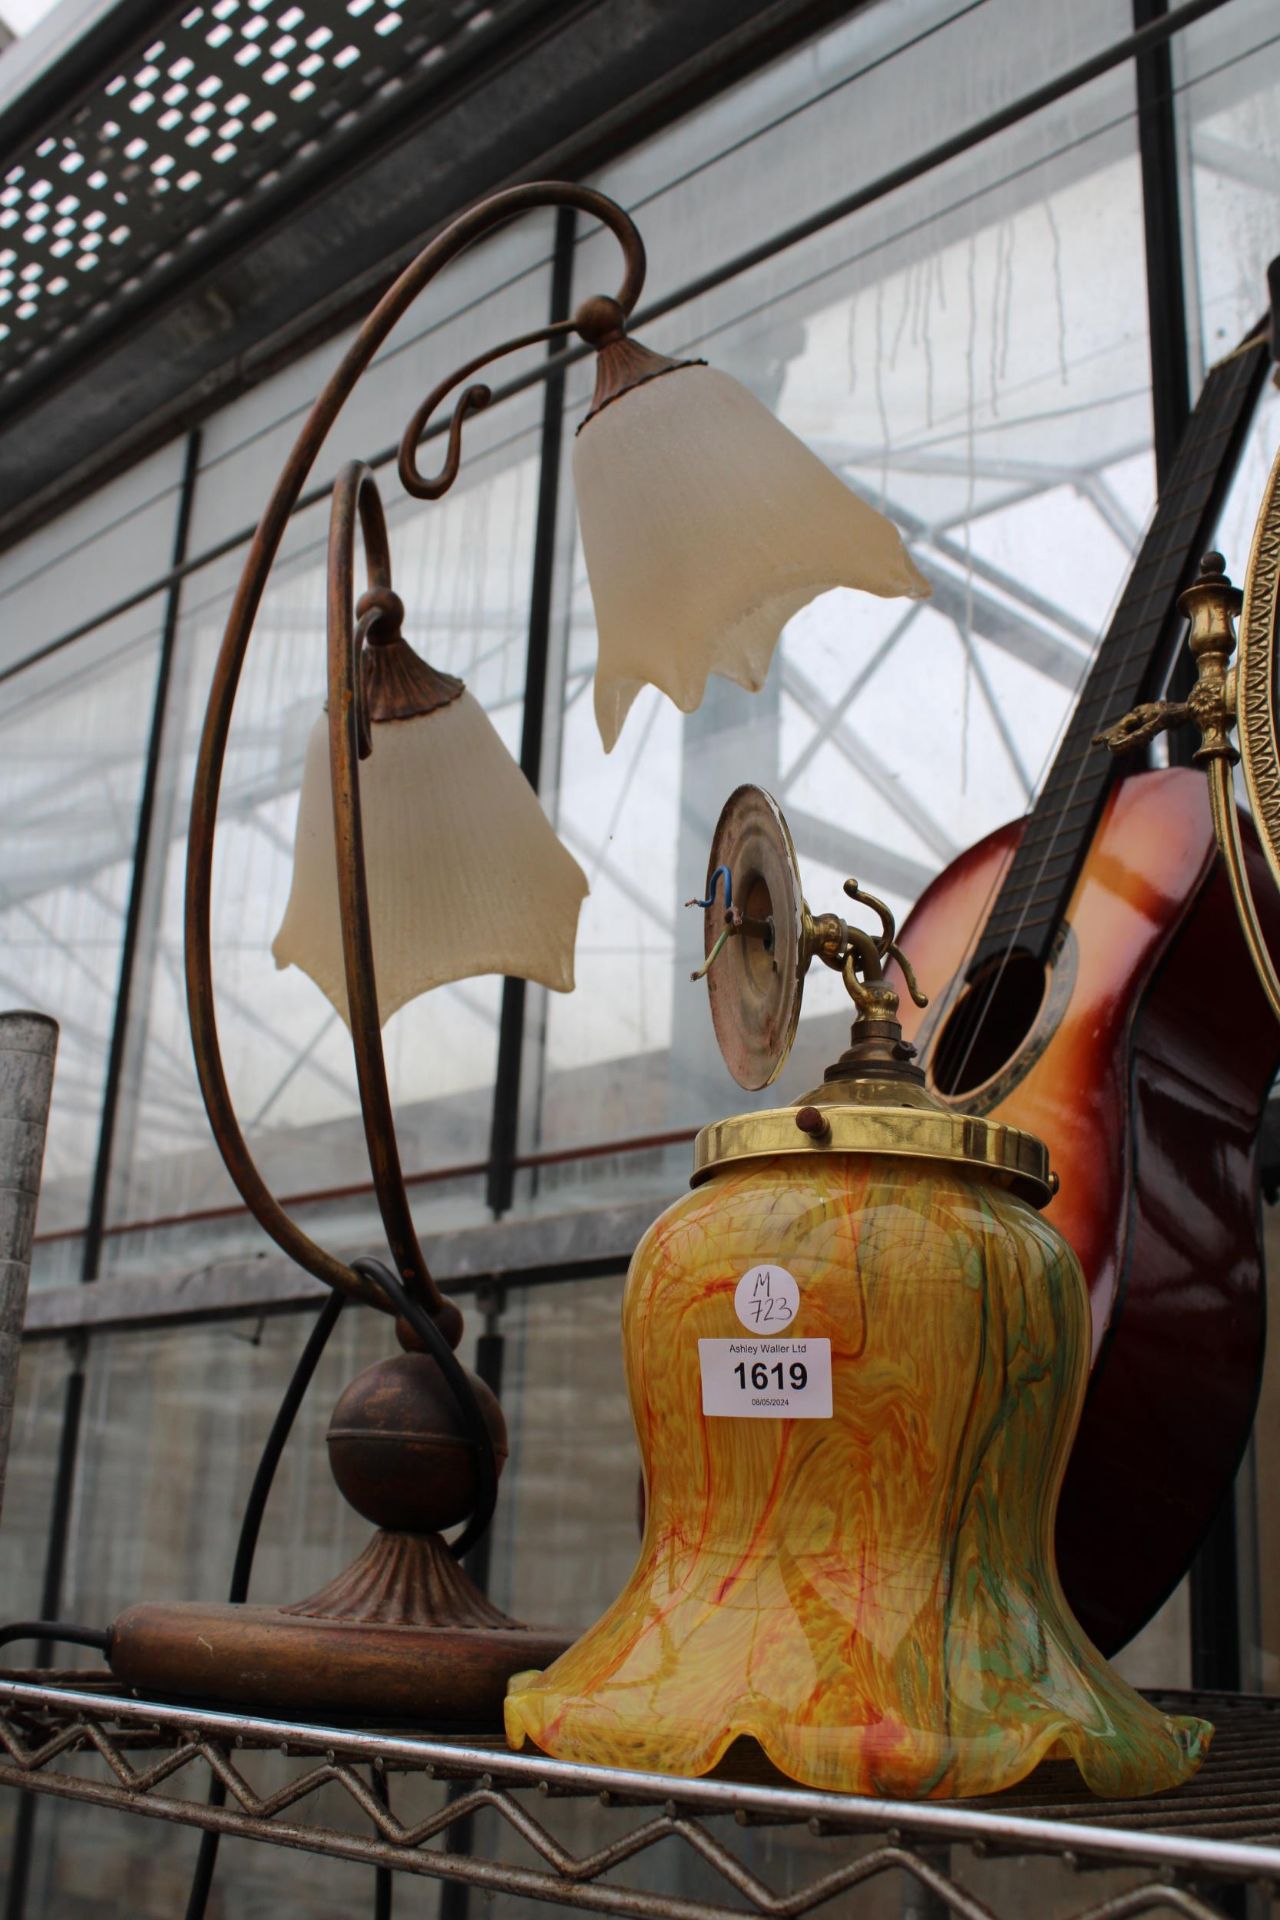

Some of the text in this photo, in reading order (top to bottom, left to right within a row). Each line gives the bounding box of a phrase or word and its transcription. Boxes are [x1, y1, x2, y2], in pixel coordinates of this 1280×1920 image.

[753, 1271, 770, 1297] M
[748, 1297, 793, 1324] 723
[729, 1344, 807, 1356] Ashley Waller Ltd
[734, 1361, 808, 1391] 1619
[751, 1398, 790, 1407] 08/05/2024
